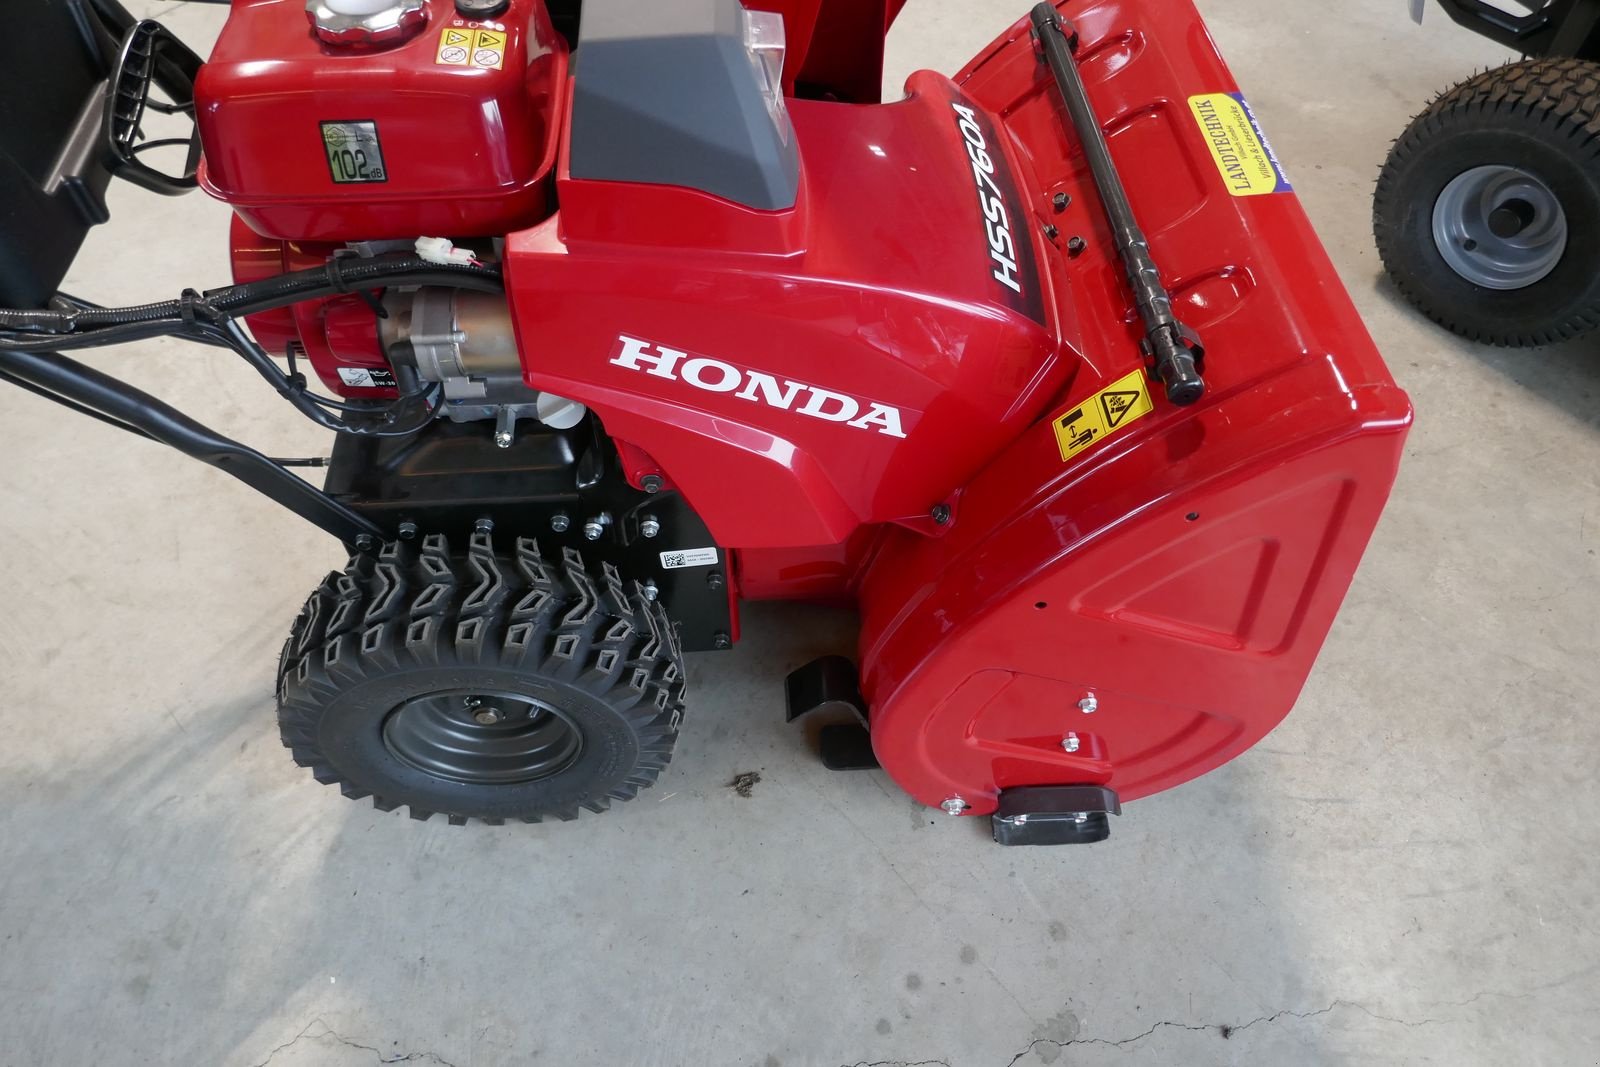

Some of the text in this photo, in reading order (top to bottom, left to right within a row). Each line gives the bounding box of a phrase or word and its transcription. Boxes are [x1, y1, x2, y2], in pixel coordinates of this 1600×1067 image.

[1195, 99, 1252, 190] LANDTECHNIK
[1226, 125, 1248, 159] Villach GmbH
[1230, 104, 1256, 148] Lieserbrücke
[332, 149, 383, 180] 102 dB
[1253, 154, 1272, 179] Villach
[952, 102, 1021, 293] HSS760A
[609, 335, 907, 438] HONDA
